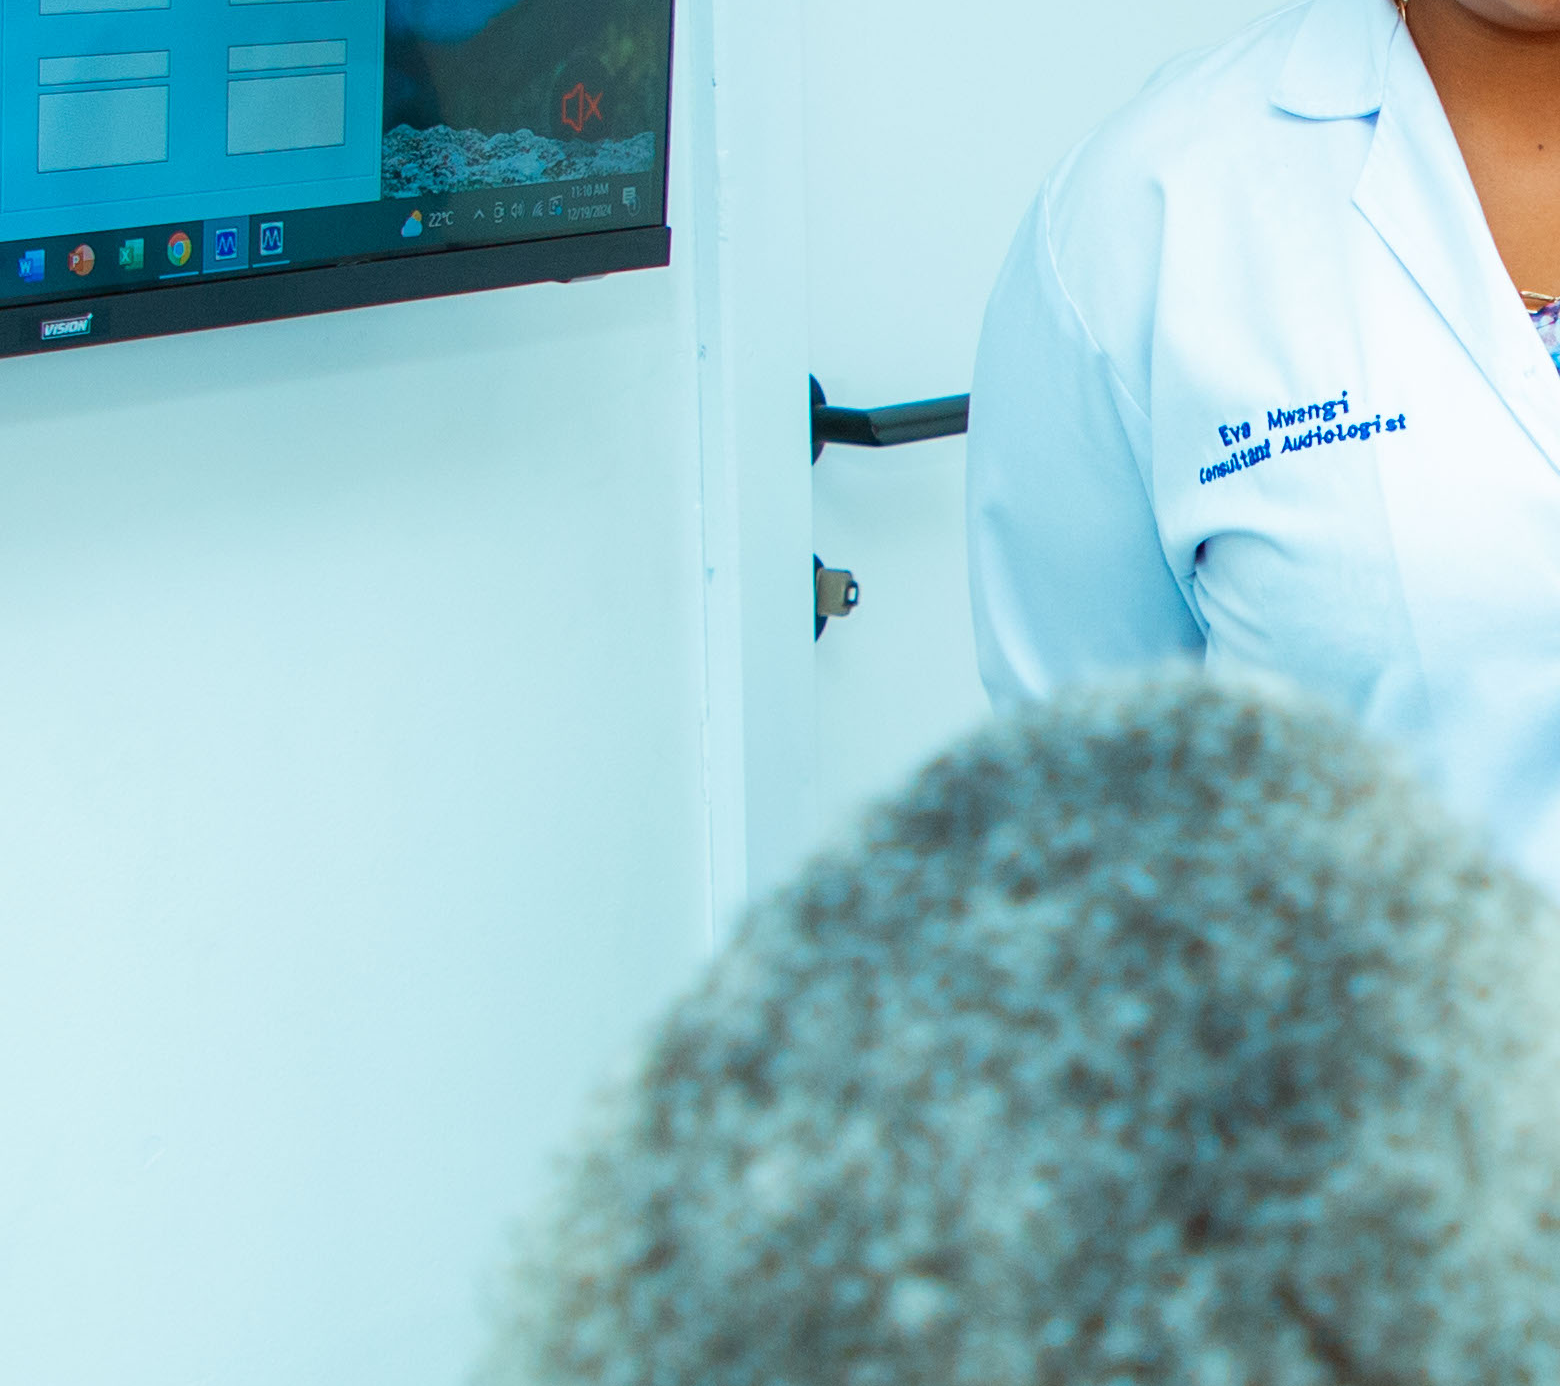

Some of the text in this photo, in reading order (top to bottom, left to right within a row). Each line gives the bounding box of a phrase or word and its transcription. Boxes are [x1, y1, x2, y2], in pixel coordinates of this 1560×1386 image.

[1217, 389, 1350, 447] Eva Mwangi
[1280, 413, 1407, 454] Audiologist
